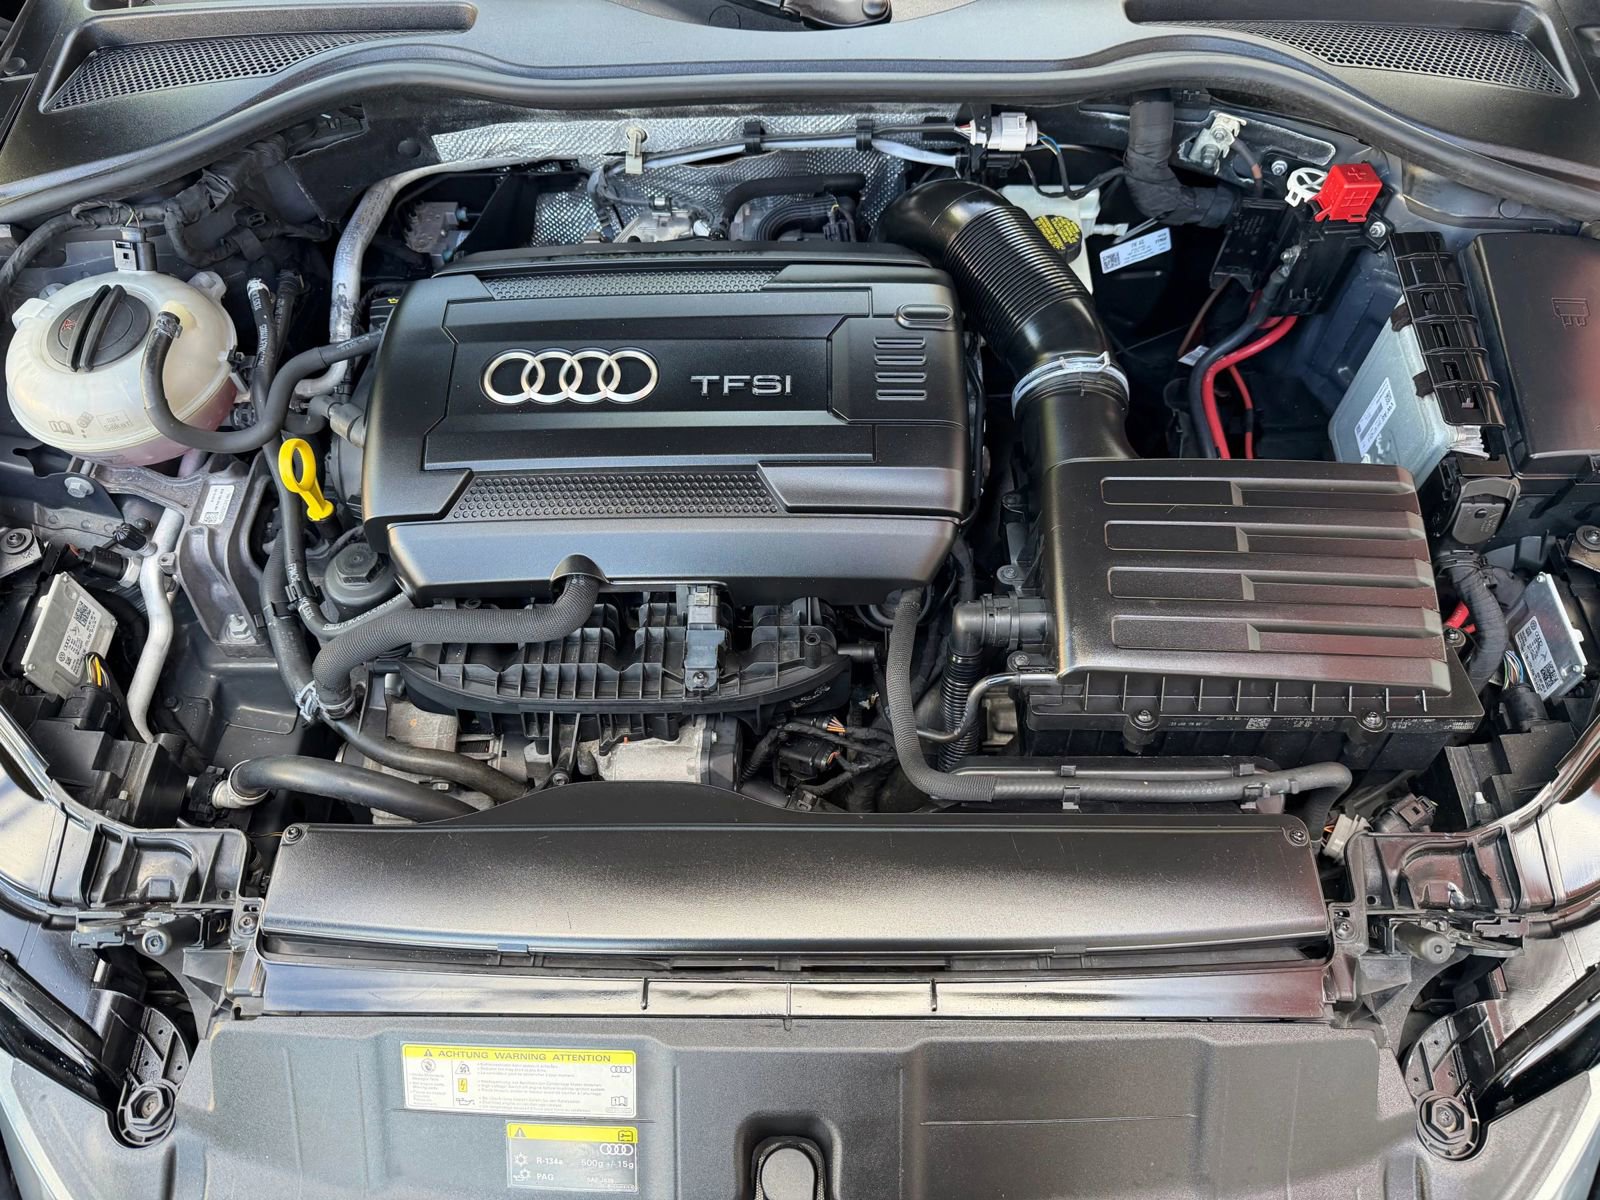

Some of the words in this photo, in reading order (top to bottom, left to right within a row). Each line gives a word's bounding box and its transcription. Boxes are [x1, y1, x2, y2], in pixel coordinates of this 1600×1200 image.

[690, 374, 793, 396] TFSI
[438, 1050, 489, 1060] ACHTUNG
[494, 1052, 547, 1061] WARNING
[552, 1053, 611, 1063] ATTENTION
[581, 1159, 604, 1168] 500g
[536, 1173, 554, 1181] PAG
